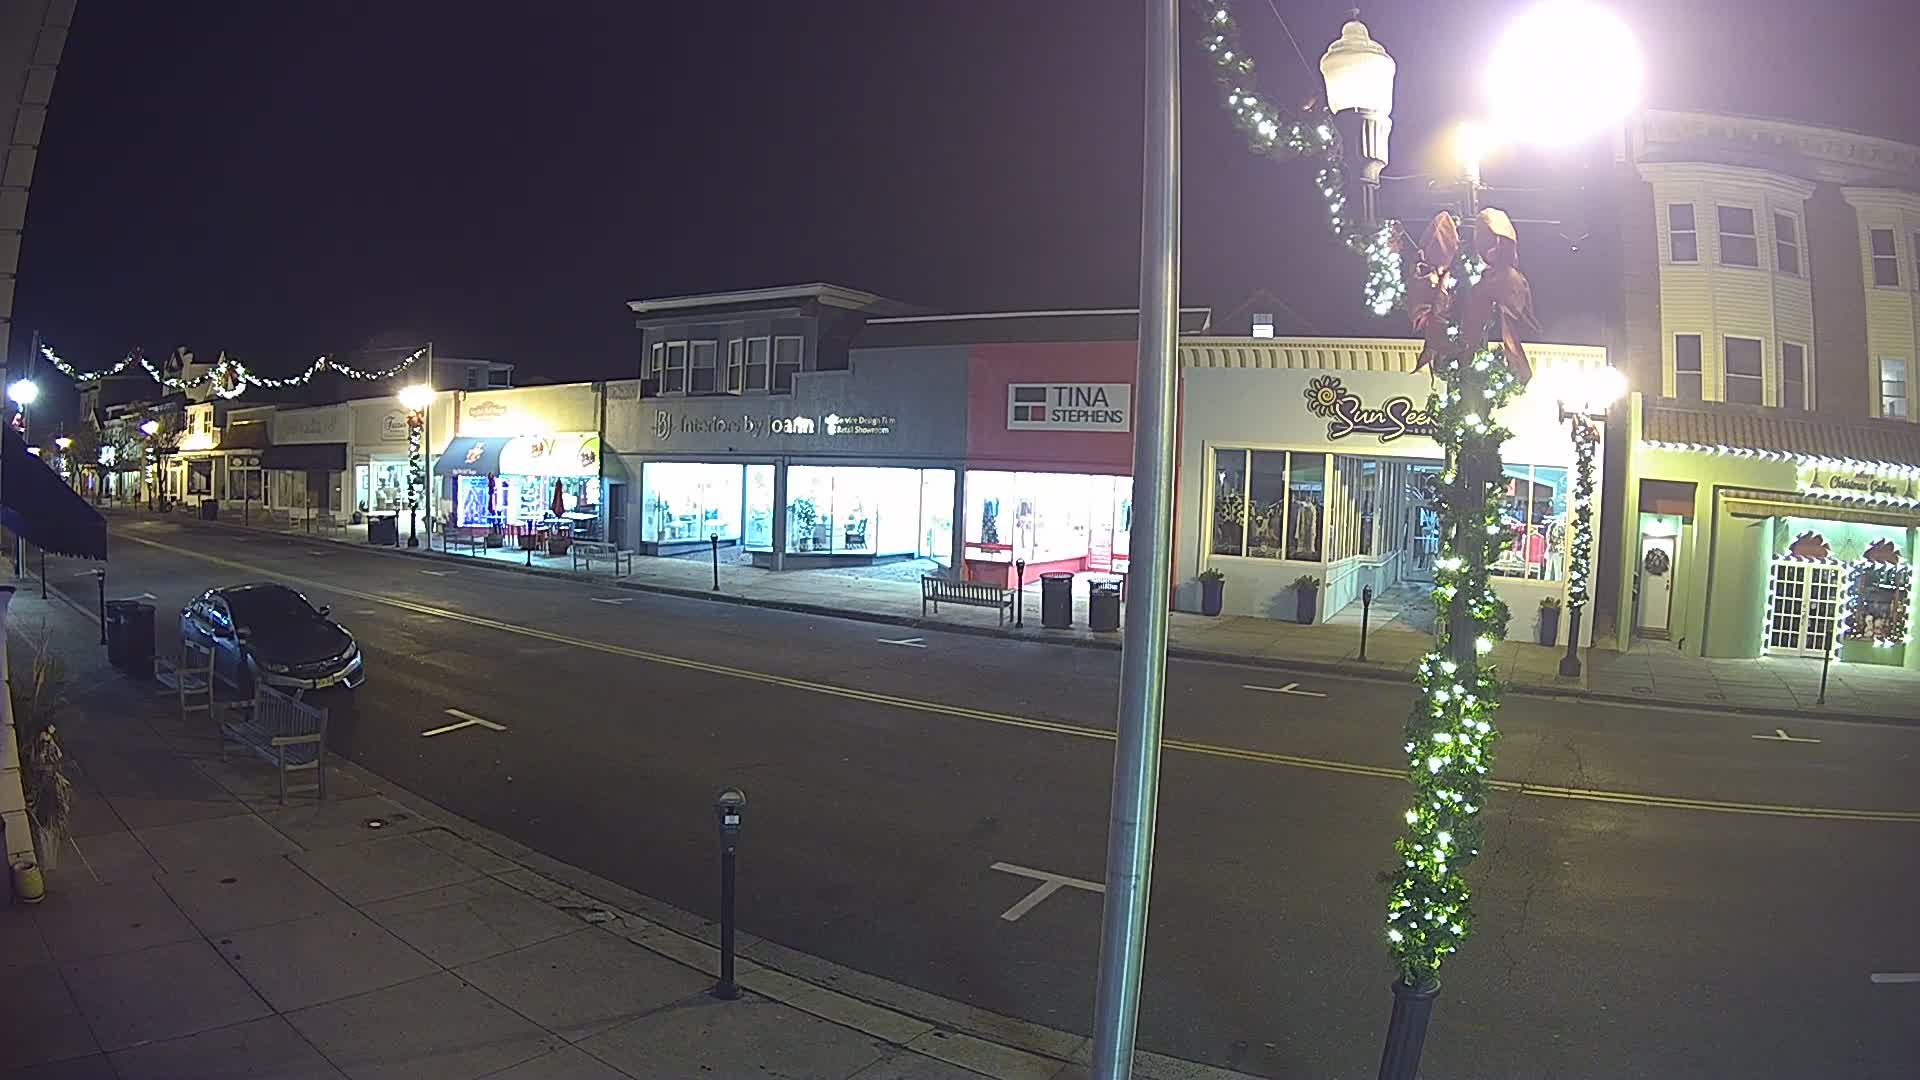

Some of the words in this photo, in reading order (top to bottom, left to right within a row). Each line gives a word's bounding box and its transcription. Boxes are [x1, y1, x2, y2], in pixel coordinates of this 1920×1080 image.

[1053, 386, 1109, 407] TINA
[1051, 408, 1124, 424] STEPHENS
[681, 415, 741, 433] Interiors
[744, 415, 764, 438] by
[1829, 475, 1869, 491] Christmas
